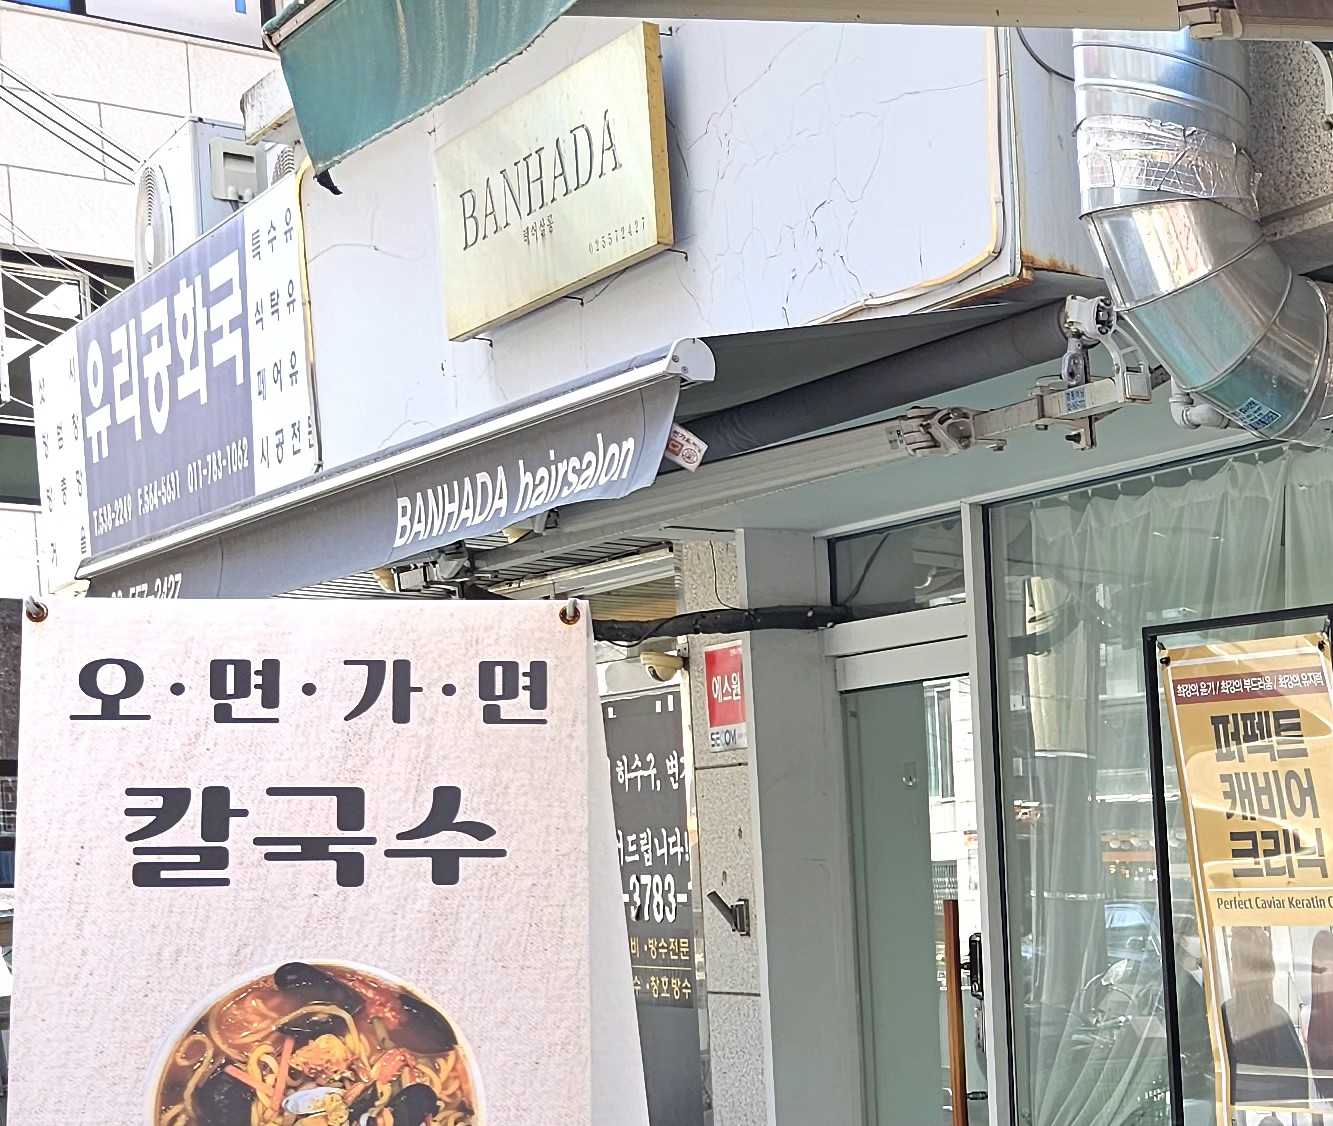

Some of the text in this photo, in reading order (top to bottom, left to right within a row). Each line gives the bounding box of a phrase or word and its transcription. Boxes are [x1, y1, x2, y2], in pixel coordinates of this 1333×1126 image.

[459, 109, 622, 251] BANHADA
[85, 249, 244, 464] 유리공화국
[393, 433, 635, 548] BANHADA hairsalon
[711, 671, 742, 703] 에스원
[710, 728, 738, 748] SECOM
[1210, 708, 1309, 763] 퍼펙트
[1219, 767, 1320, 821] 캐비어
[124, 785, 508, 888] 칼국수
[1229, 827, 1329, 879] 클리닉
[1217, 894, 1327, 910] Perfect Caviar Keratin
